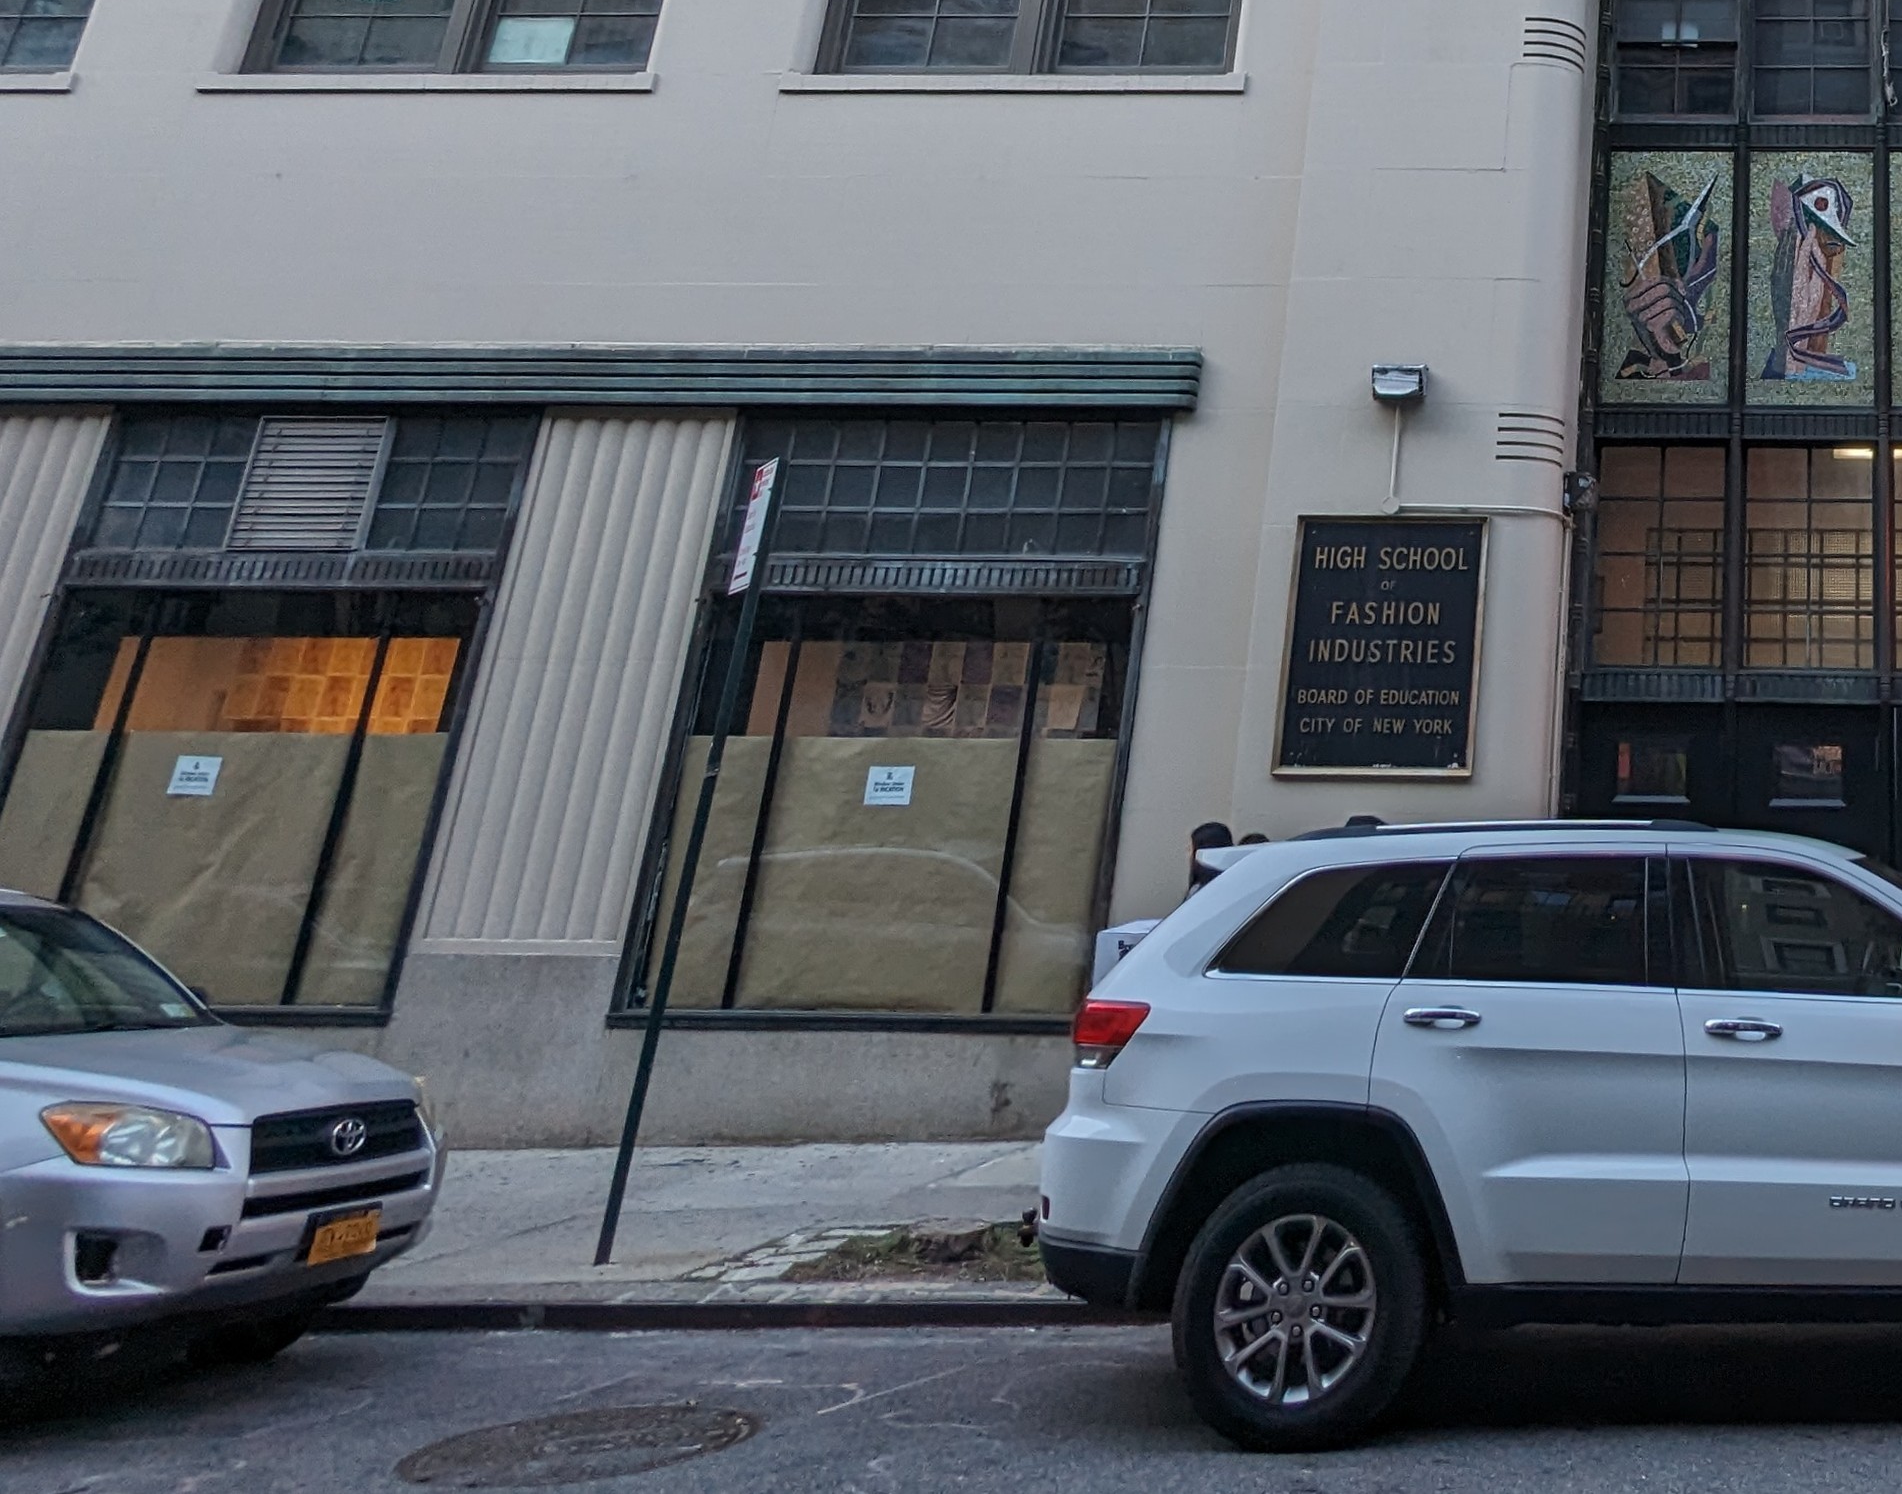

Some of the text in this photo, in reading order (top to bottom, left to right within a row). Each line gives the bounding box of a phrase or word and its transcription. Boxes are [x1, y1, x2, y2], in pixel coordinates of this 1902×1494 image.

[1314, 546, 1468, 570] HIGH SCHOOL
[1381, 580, 1396, 591] OF
[1331, 601, 1440, 625] FASHION
[1308, 639, 1456, 663] INDUSTRIES
[1297, 688, 1460, 706] BOARD OF EDUCATION
[1300, 717, 1452, 735] CITY OF NEW YORK
